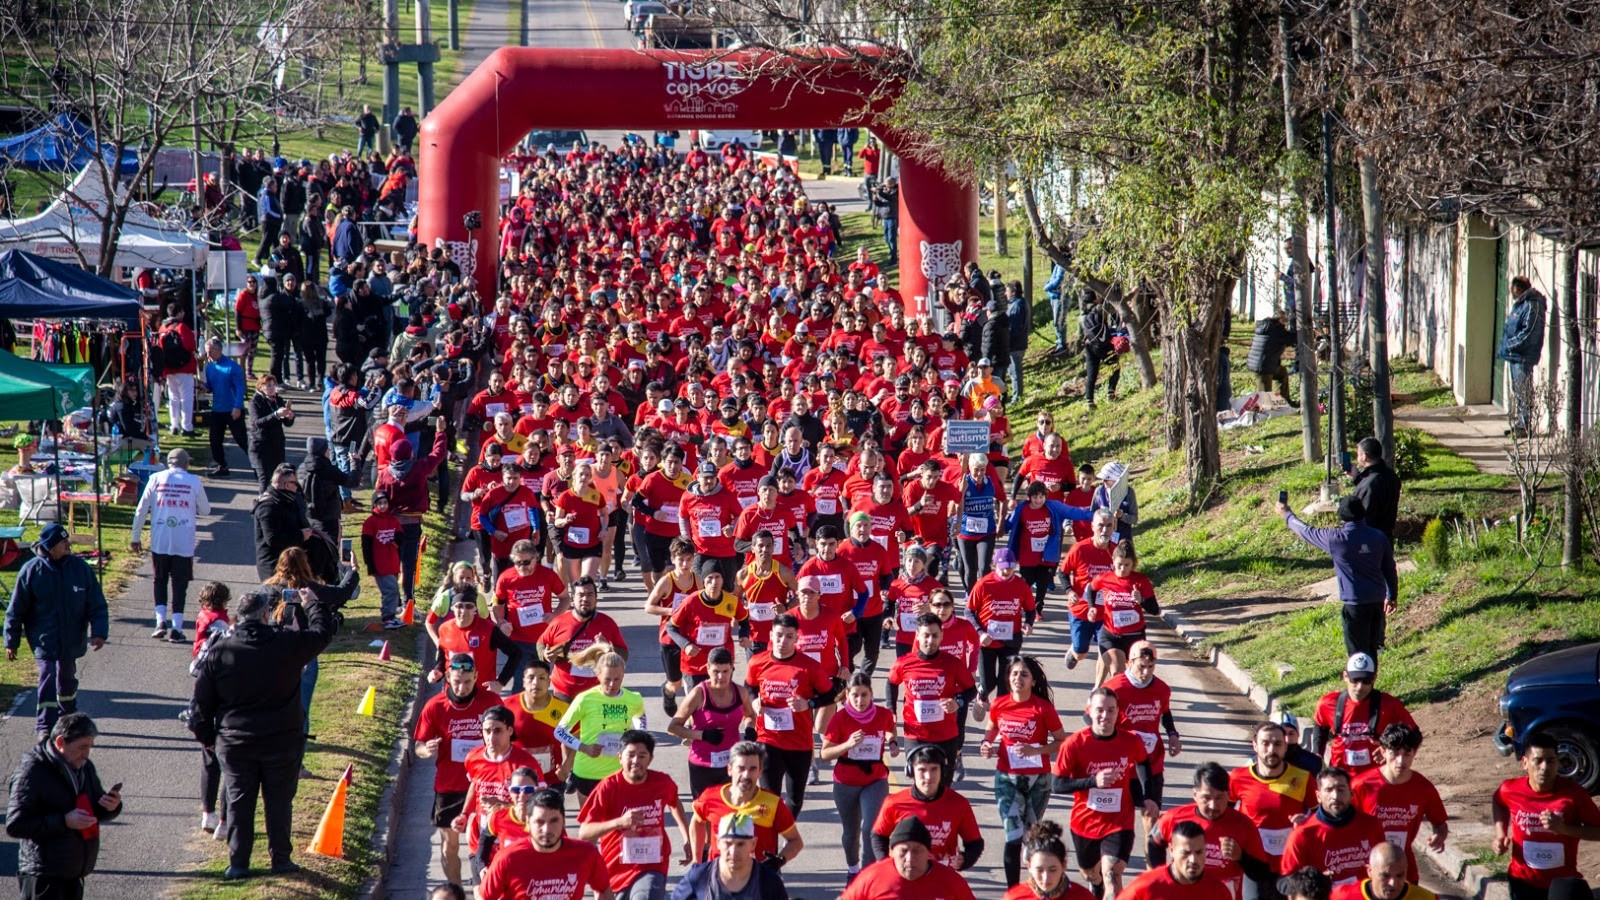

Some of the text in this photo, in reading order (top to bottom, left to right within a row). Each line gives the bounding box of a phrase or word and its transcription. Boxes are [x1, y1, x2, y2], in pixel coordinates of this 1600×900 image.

[662, 61, 739, 80] TIGRE
[666, 82, 739, 95] con vos
[950, 427, 987, 436] hablemos de
[949, 434, 988, 443] autismo
